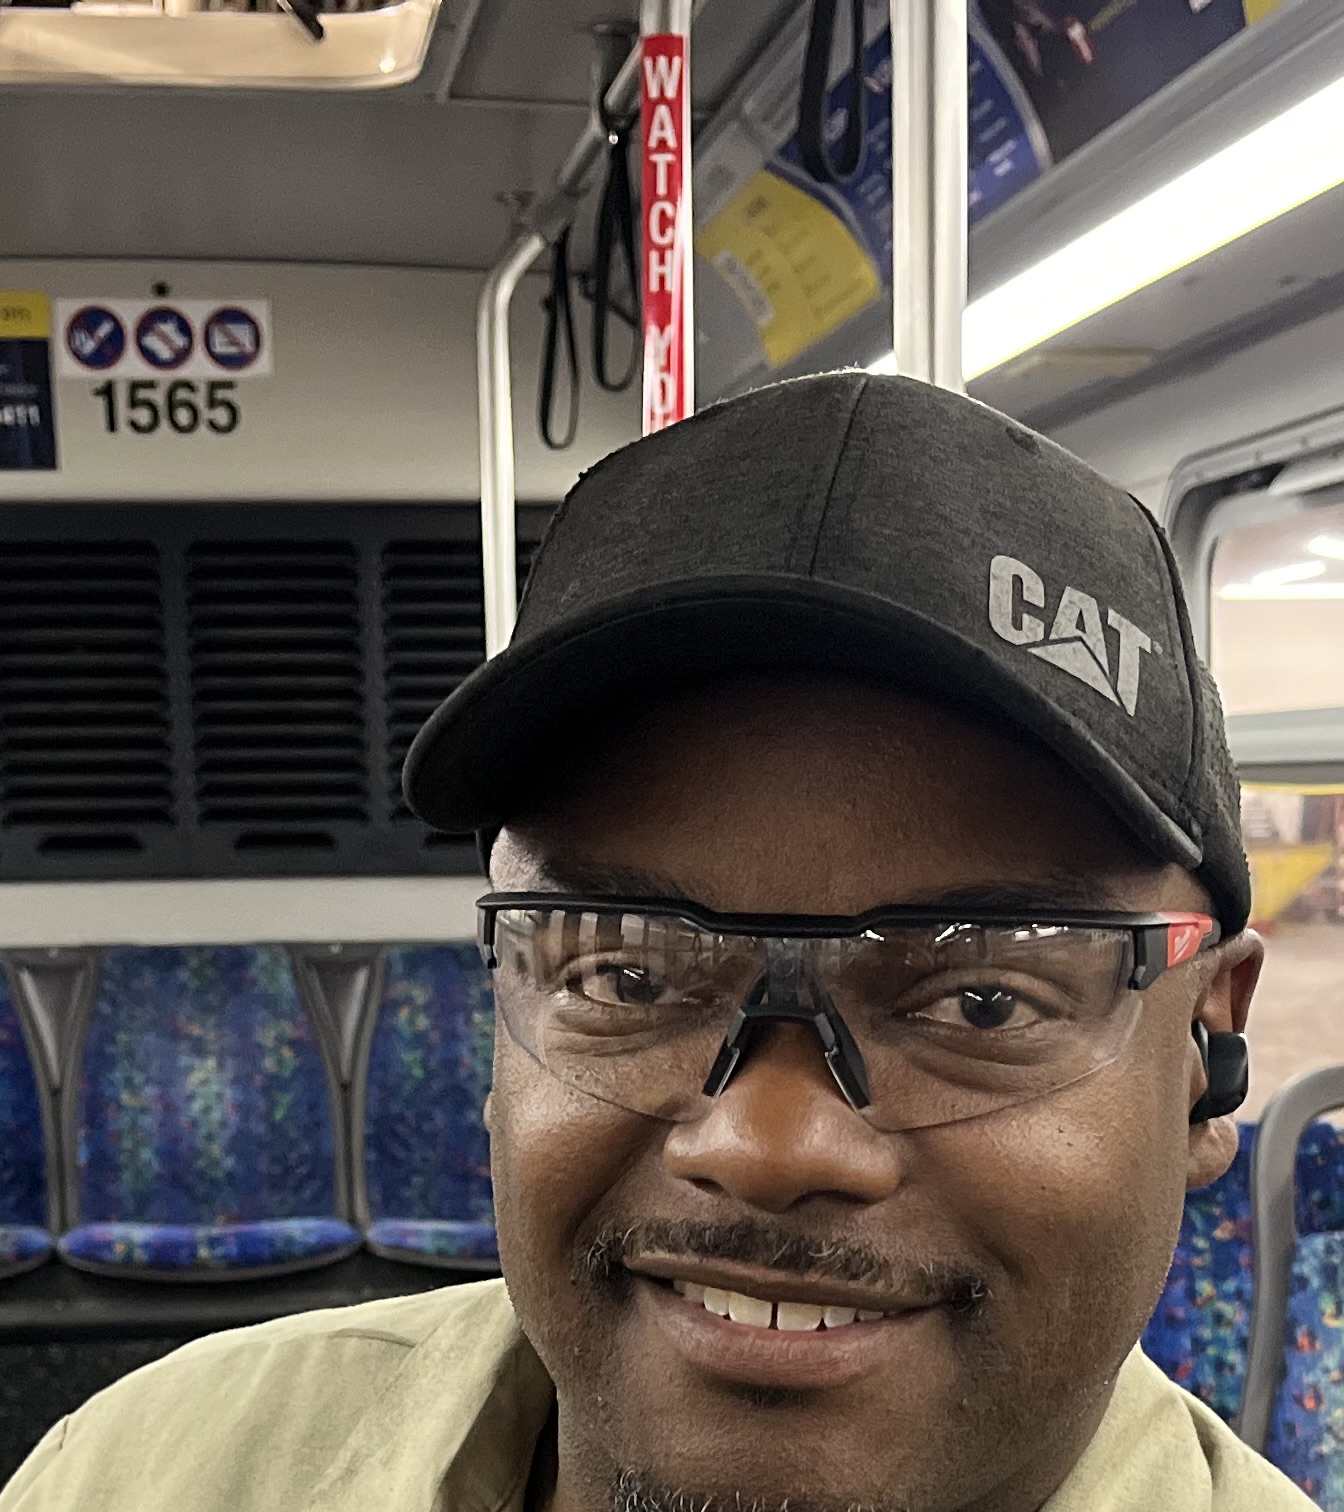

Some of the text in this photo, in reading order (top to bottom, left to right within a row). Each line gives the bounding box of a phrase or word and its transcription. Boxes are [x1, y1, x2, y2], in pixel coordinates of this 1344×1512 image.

[644, 54, 682, 293] WATCH
[93, 379, 240, 434] 1565
[988, 554, 1152, 717] CAT
